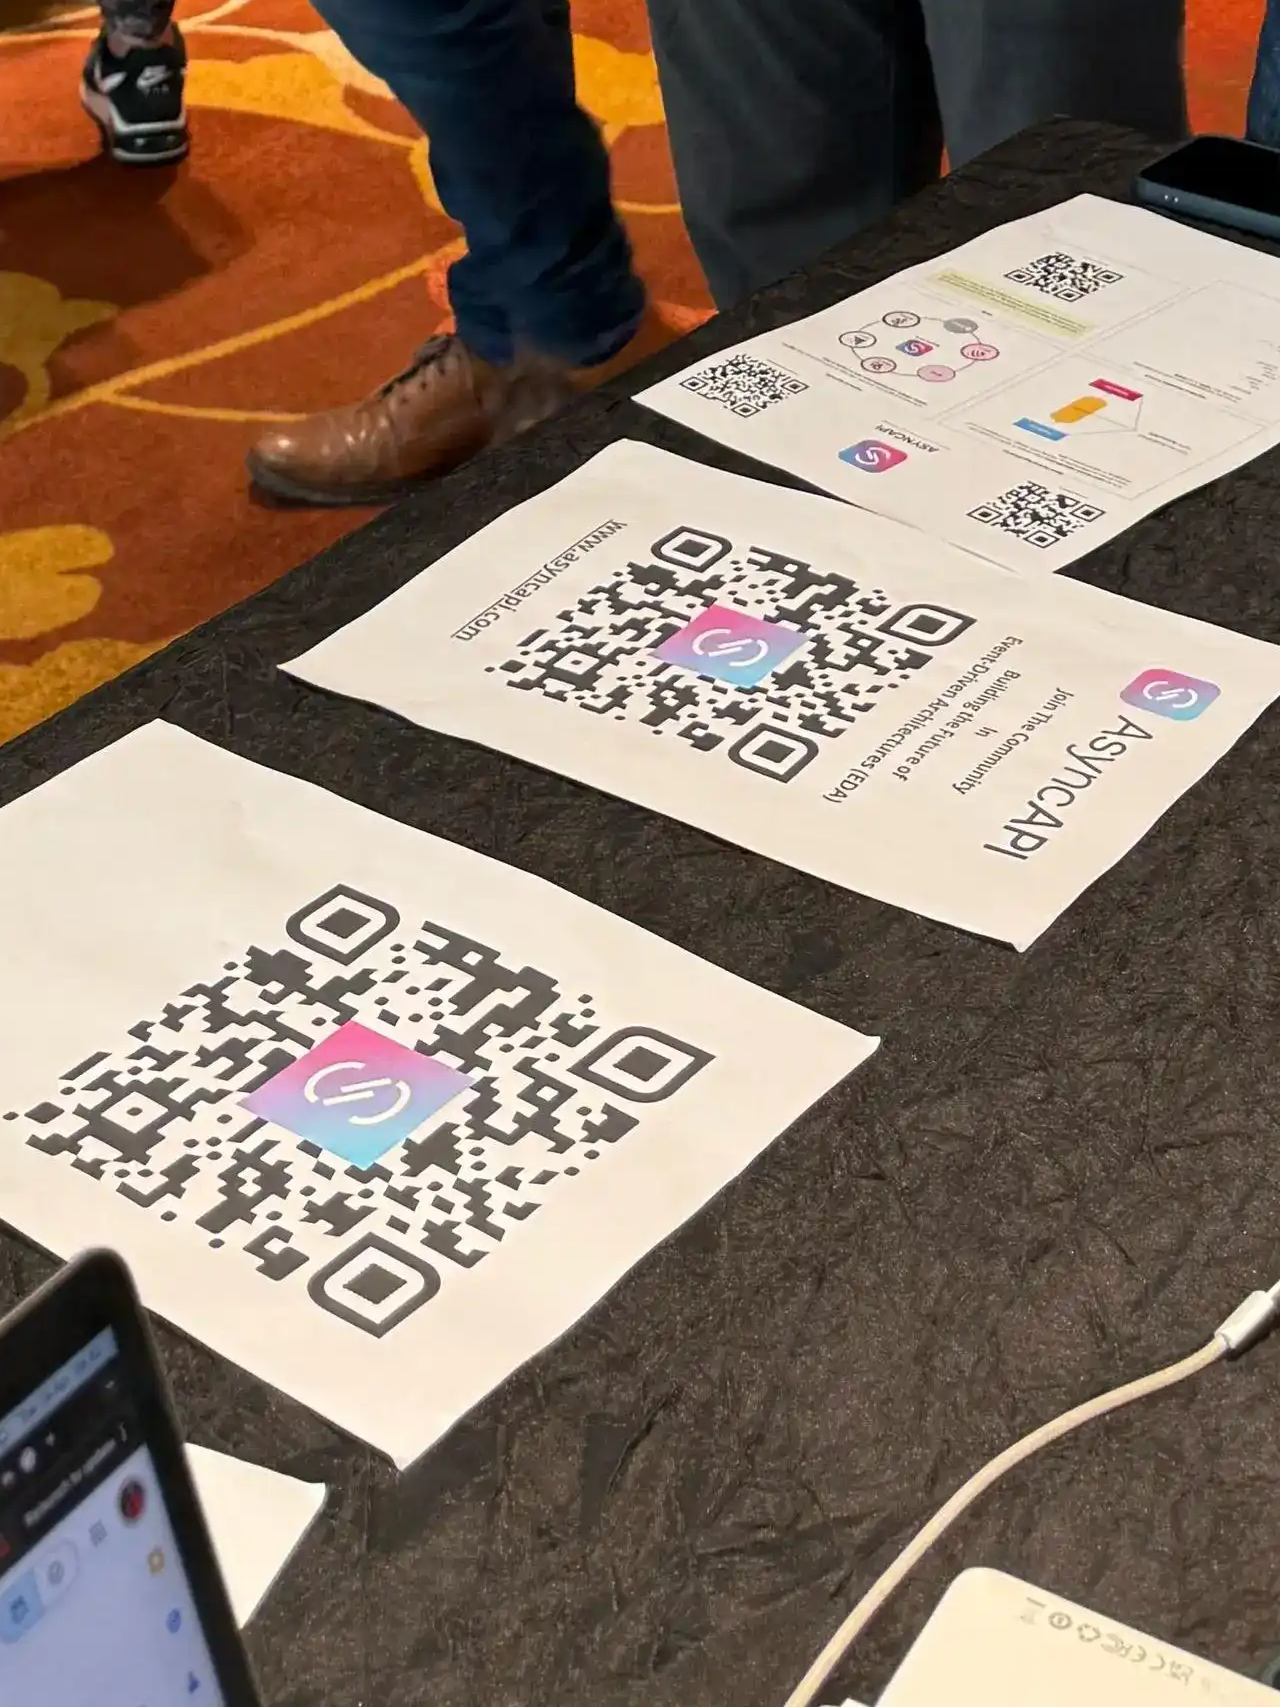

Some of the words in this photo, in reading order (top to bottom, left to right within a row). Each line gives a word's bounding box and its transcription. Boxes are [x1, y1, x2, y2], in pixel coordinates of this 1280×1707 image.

[452, 518, 628, 642] www.asyncapi.com
[942, 636, 1023, 699] Event-Driven
[963, 670, 1021, 710] Building
[1043, 687, 1074, 713] Join
[861, 698, 949, 770] Architectures
[951, 709, 978, 731] the
[976, 726, 1000, 738] In
[1021, 710, 1052, 733] The
[910, 729, 955, 767] Future
[951, 729, 1030, 795] Community
[822, 768, 870, 804] (EDA)
[892, 762, 912, 782] of
[983, 714, 1154, 860] AsyncAPI
